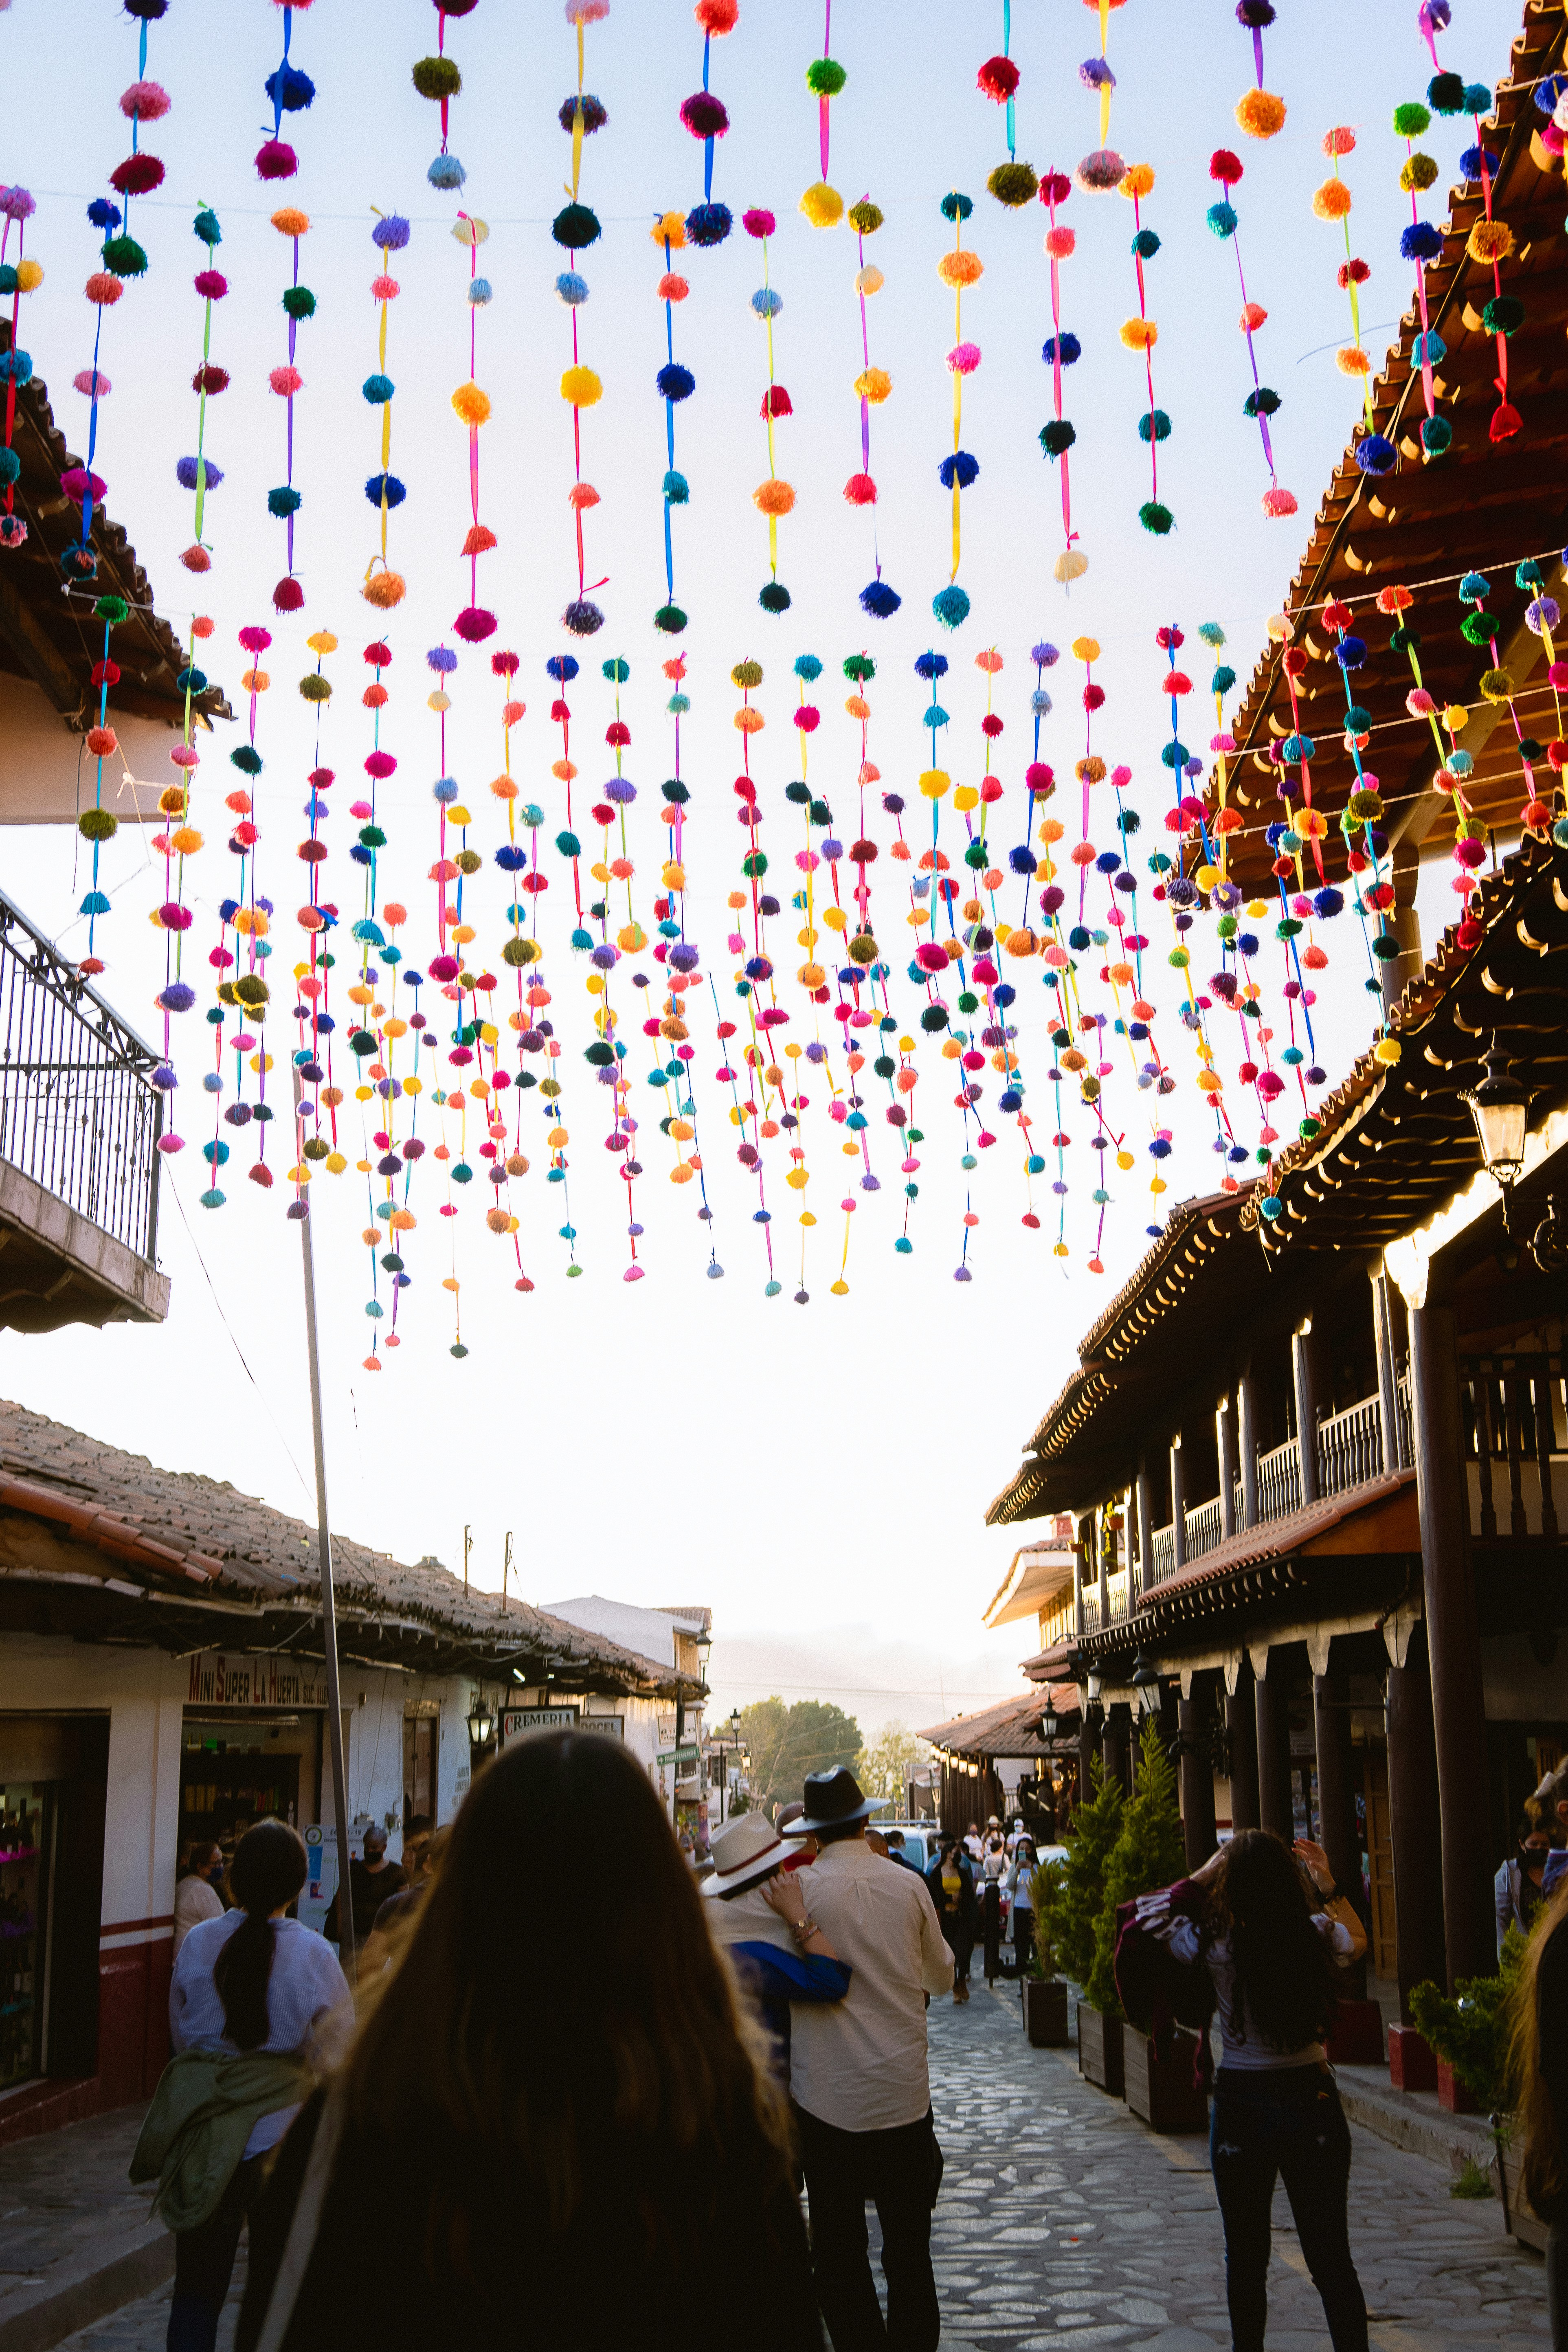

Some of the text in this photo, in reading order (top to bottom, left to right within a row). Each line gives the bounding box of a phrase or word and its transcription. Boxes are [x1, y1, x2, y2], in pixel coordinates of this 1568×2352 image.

[189, 1653, 214, 1702] MINI
[216, 1655, 249, 1703] SUPER
[253, 1659, 266, 1704] LA
[269, 1658, 299, 1704] HUERTA
[505, 1713, 571, 1737] CREMERIA
